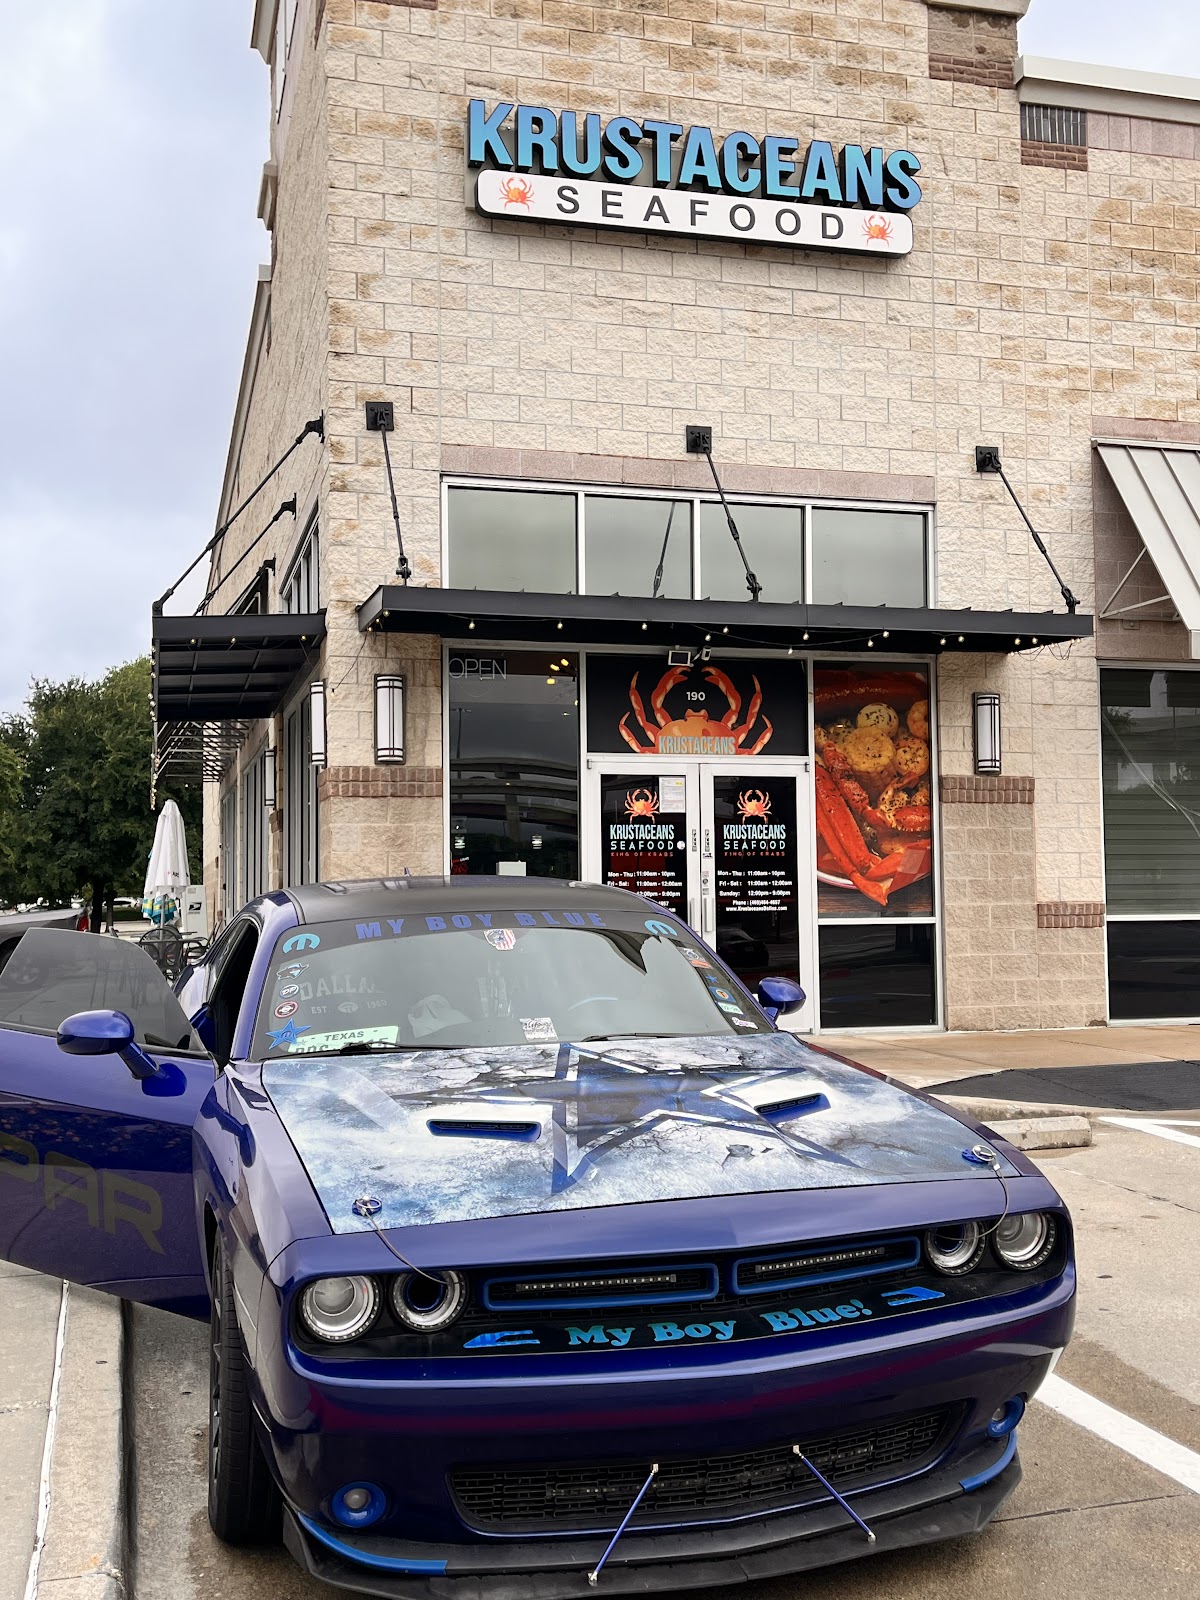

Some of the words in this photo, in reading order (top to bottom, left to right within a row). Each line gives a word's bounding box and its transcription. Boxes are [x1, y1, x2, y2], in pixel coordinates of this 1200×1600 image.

[468, 99, 922, 211] KRUSTACEANS
[557, 185, 844, 239] SEAFOOD
[449, 658, 507, 680] OPEN
[686, 692, 705, 700] 190
[659, 735, 736, 754] KRUSTACEANS
[610, 824, 674, 839] KRUSTACEANS
[723, 824, 786, 839] KRUSTACEANS
[610, 841, 674, 850] SEAFOOD
[724, 841, 786, 850] SEAFOOD
[355, 919, 404, 940] MY
[426, 914, 492, 931] BOY
[514, 911, 607, 926] BLUE
[300, 974, 384, 1000] DALLA
[324, 1031, 365, 1041] TEXAS
[567, 1325, 635, 1347] My
[653, 1318, 737, 1342] Boy
[759, 1299, 873, 1333] Blue!
